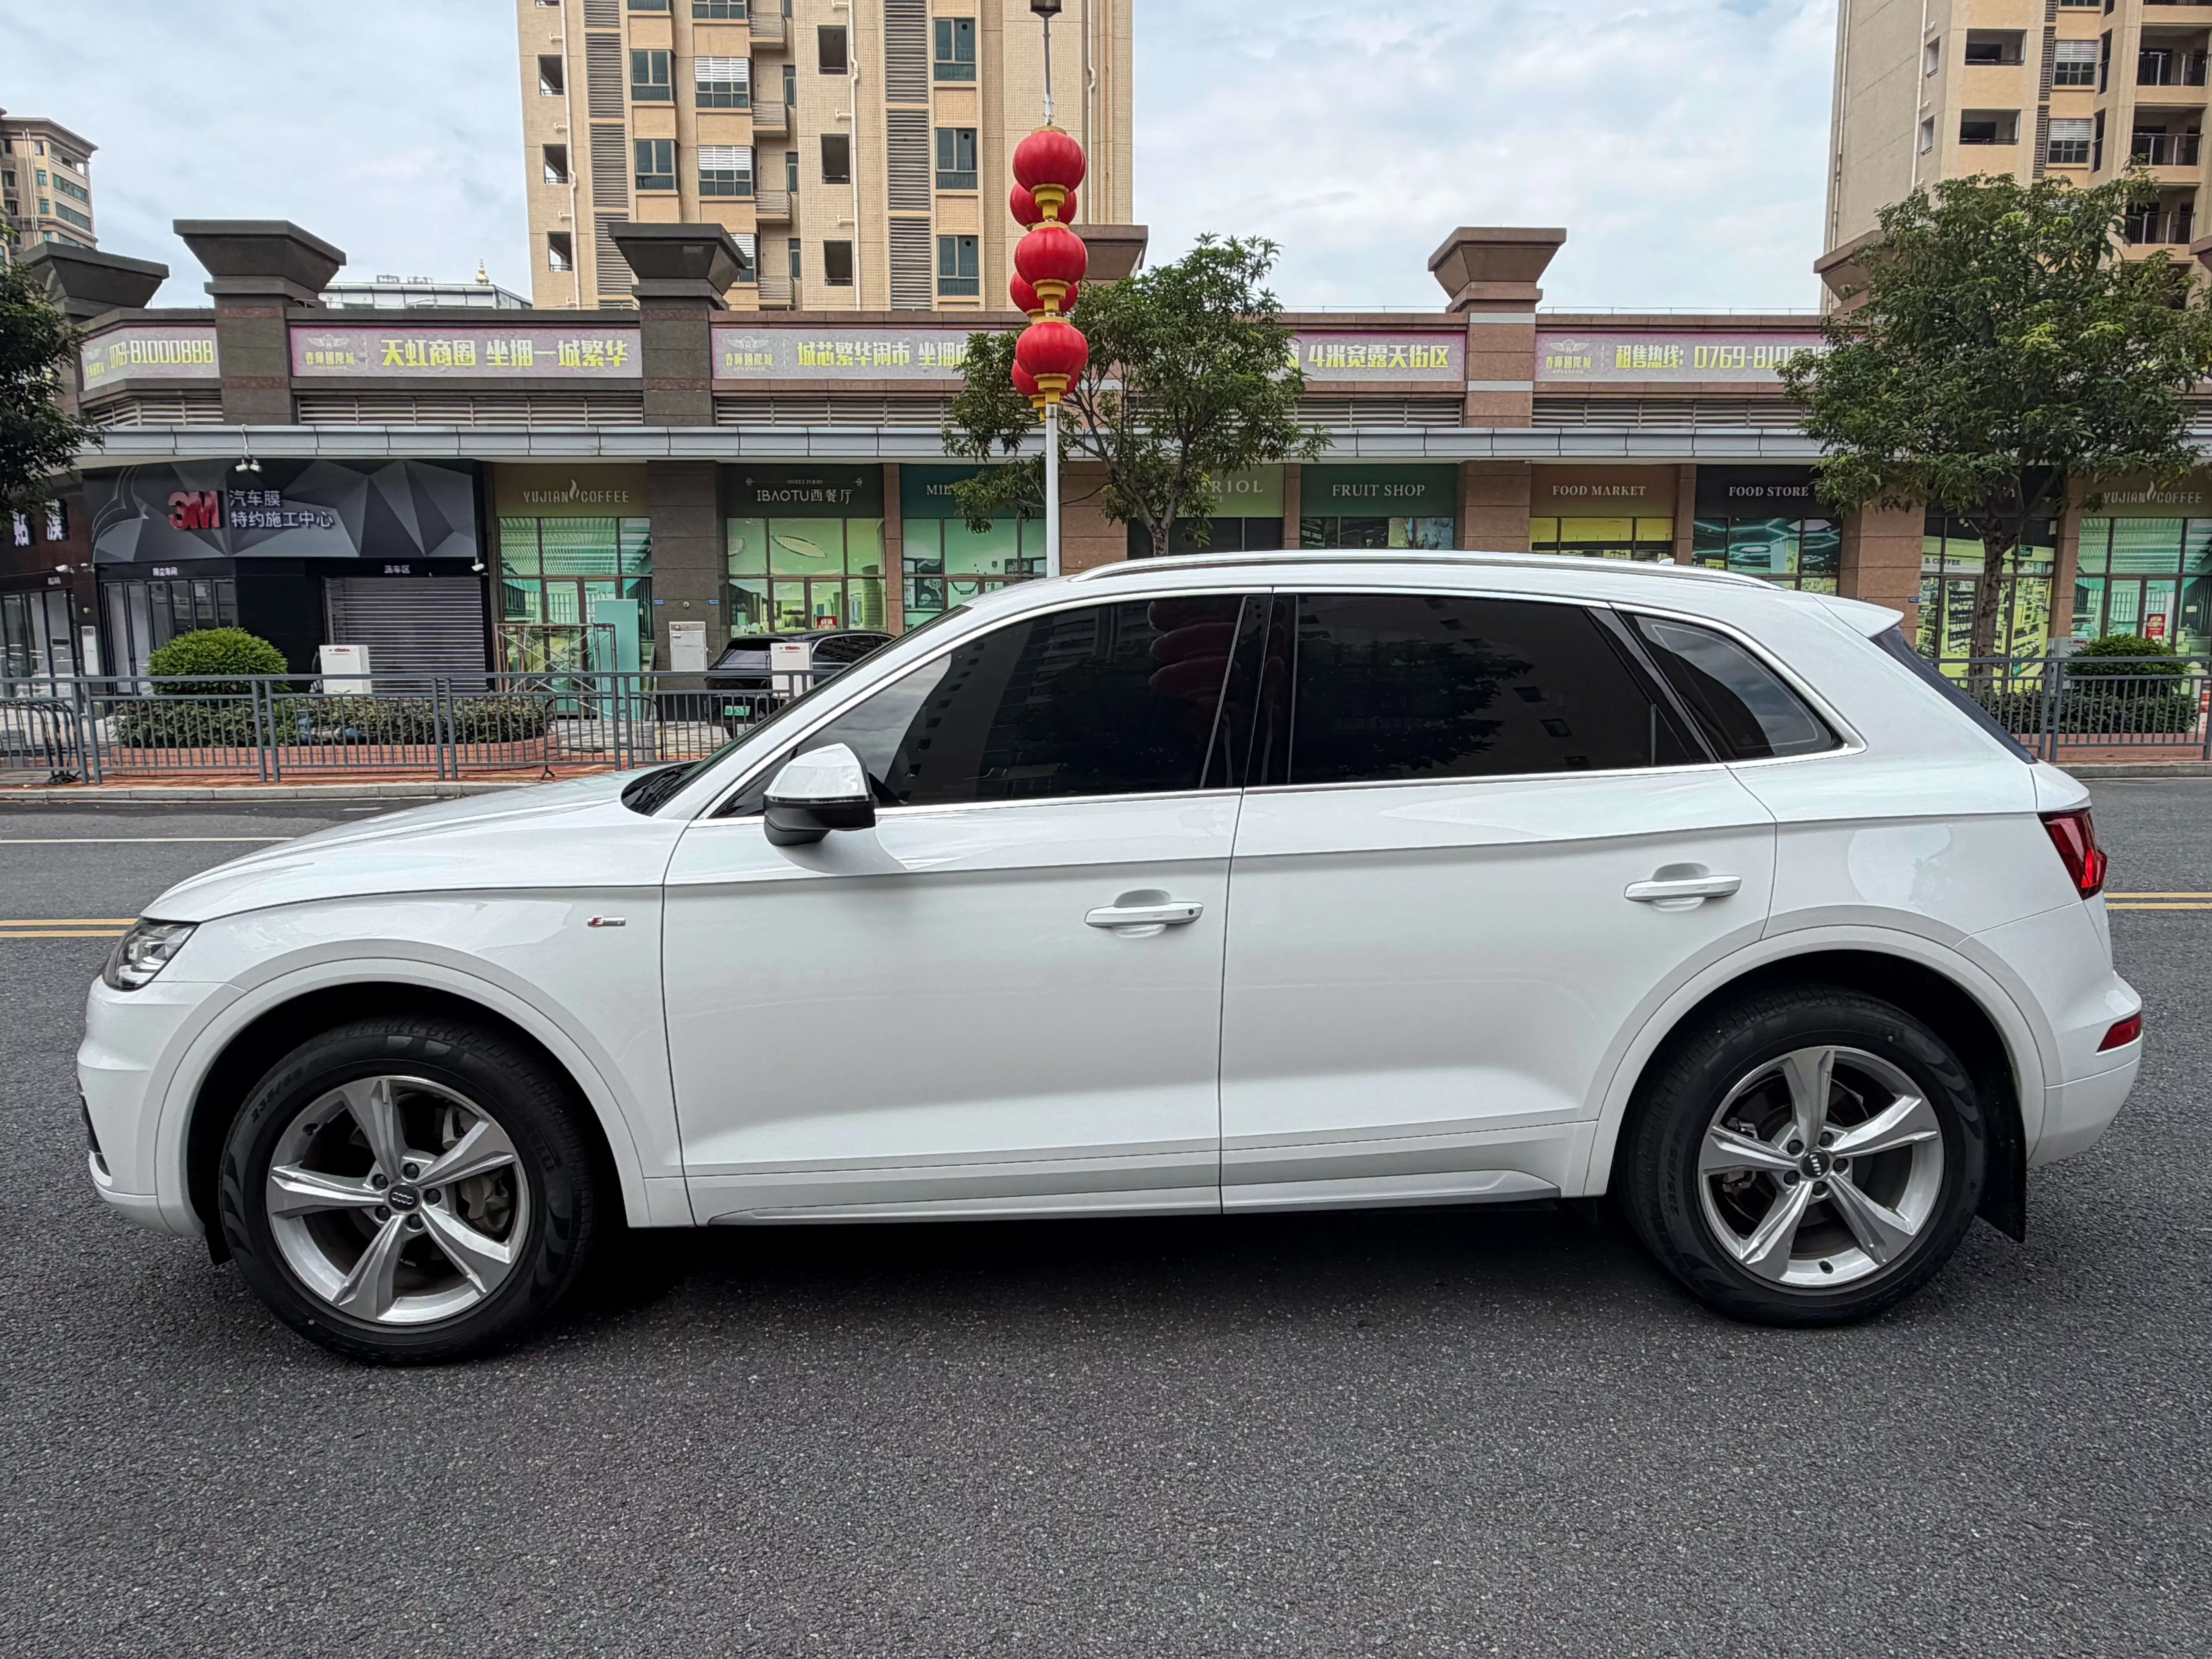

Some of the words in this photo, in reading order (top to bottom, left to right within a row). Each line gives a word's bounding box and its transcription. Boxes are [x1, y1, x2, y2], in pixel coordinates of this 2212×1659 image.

[381, 339, 476, 366] 天虹商圈
[486, 340, 628, 367] 坐拥一城繁华
[797, 342, 910, 366] 城芯繁华闹市
[1309, 344, 1449, 368] 4米宽露天街区
[229, 490, 282, 507] 汽车膜
[523, 490, 568, 503] YUJIAN
[581, 490, 629, 503] COFFEE
[1332, 484, 1379, 496] FRUIT
[1384, 484, 1425, 496] SHOP
[1553, 485, 1588, 496] FOOD
[1591, 485, 1647, 496] MARKET
[1729, 486, 1764, 496] FOOD
[1767, 486, 1809, 496] STORE
[2104, 491, 2145, 503] YUJIAN
[2157, 491, 2203, 503] COFFEE
[168, 491, 220, 531] 3M
[231, 511, 333, 528] 特约施工中心
